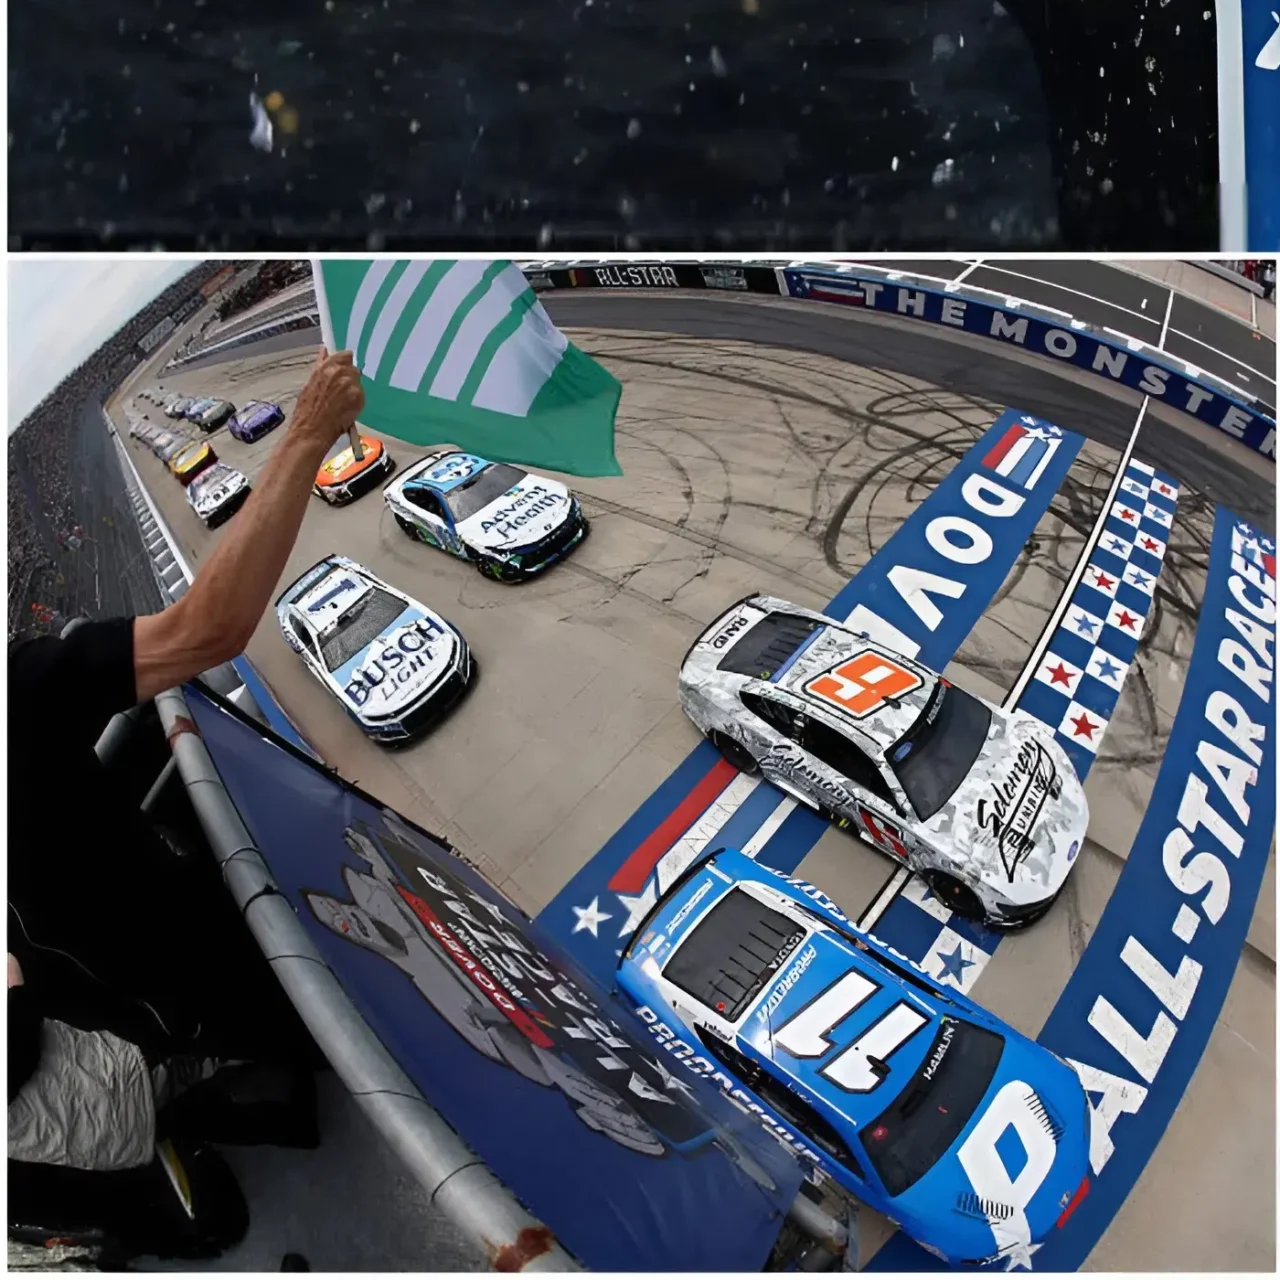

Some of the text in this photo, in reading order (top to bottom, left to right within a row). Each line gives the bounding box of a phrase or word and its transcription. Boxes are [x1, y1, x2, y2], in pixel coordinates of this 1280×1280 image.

[595, 265, 680, 288] ALL-STAR
[859, 283, 968, 327] THE
[344, 616, 445, 707] BUSCH
[380, 646, 438, 701] LIGHT
[1065, 690, 1266, 1177] ALL-STAR
[774, 966, 932, 1095] 11
